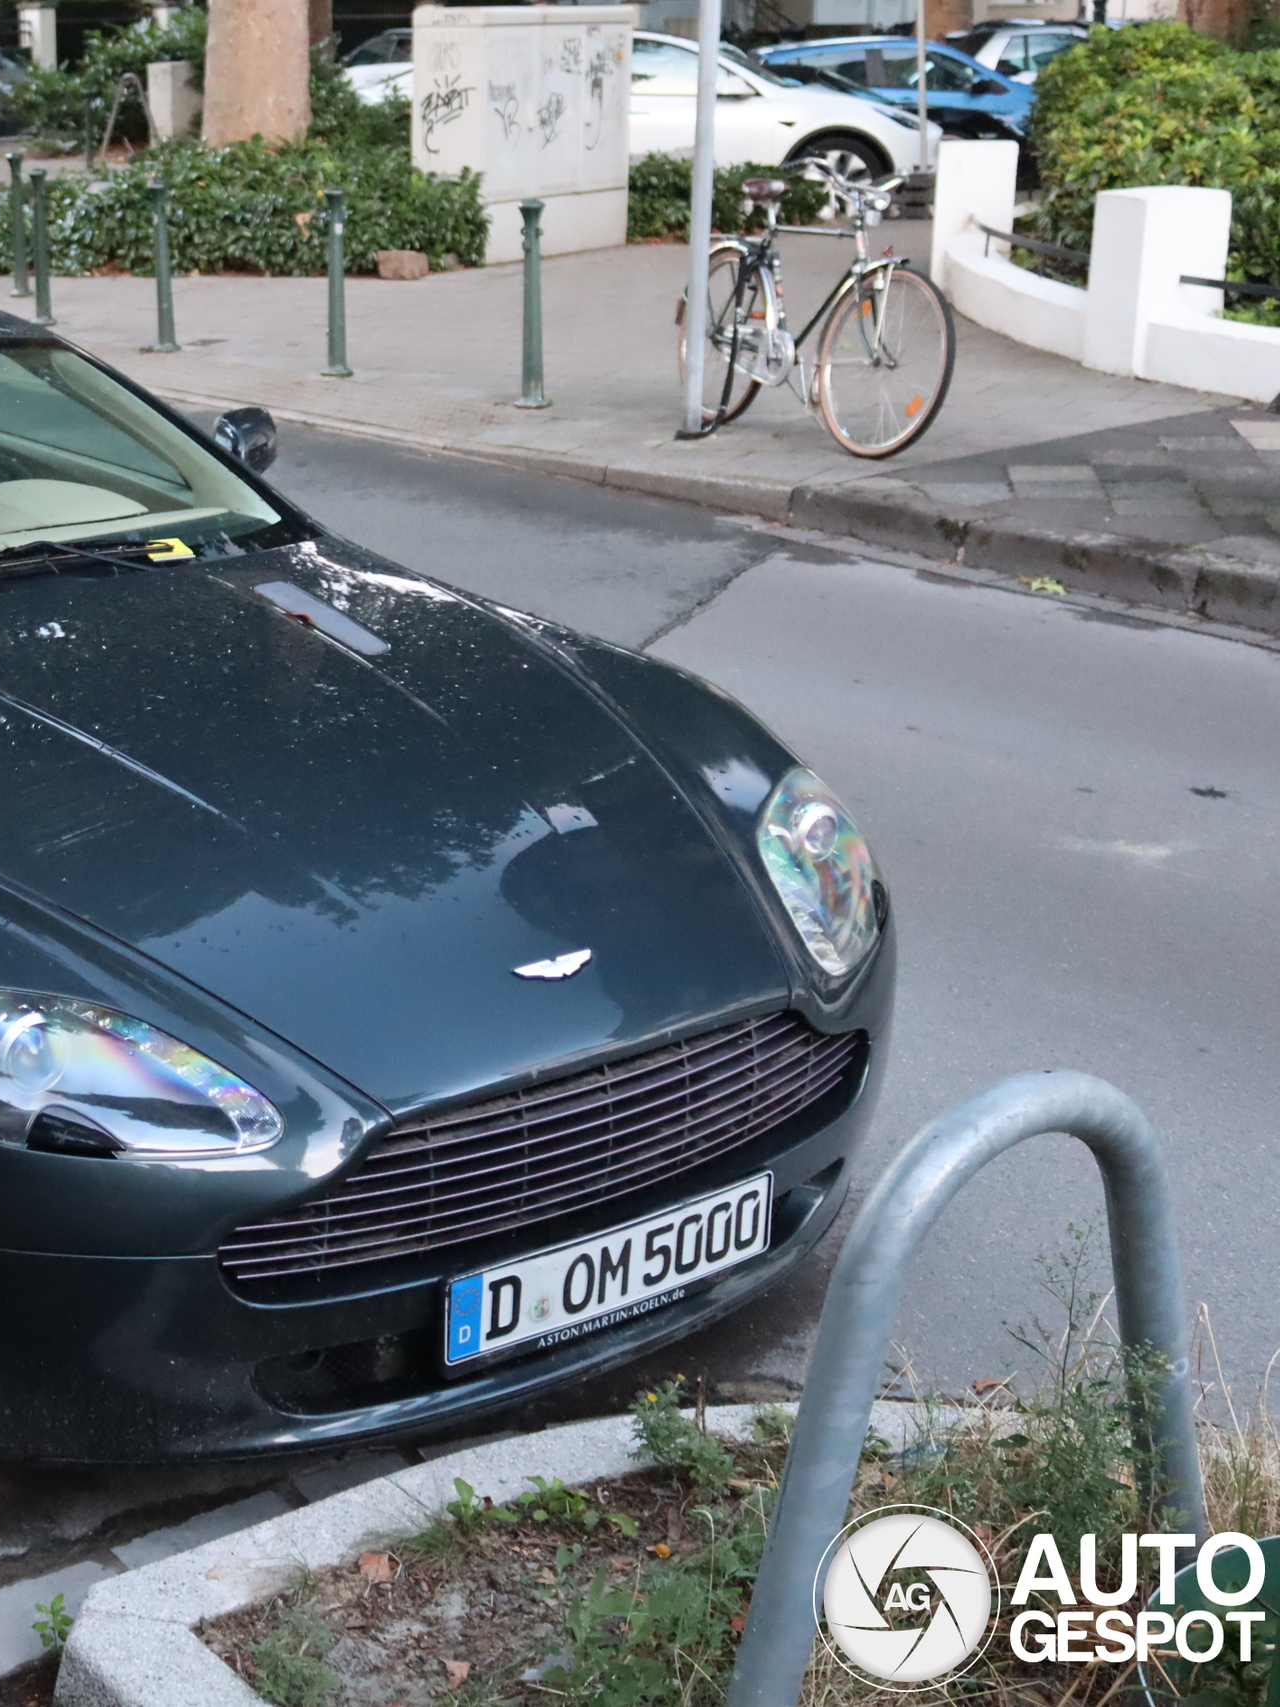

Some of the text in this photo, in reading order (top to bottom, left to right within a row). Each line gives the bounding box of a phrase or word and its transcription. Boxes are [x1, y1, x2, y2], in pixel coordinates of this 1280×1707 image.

[486, 1190, 760, 1340] D OM 5000
[458, 1325, 471, 1344] D
[537, 1326, 579, 1348] ASTON
